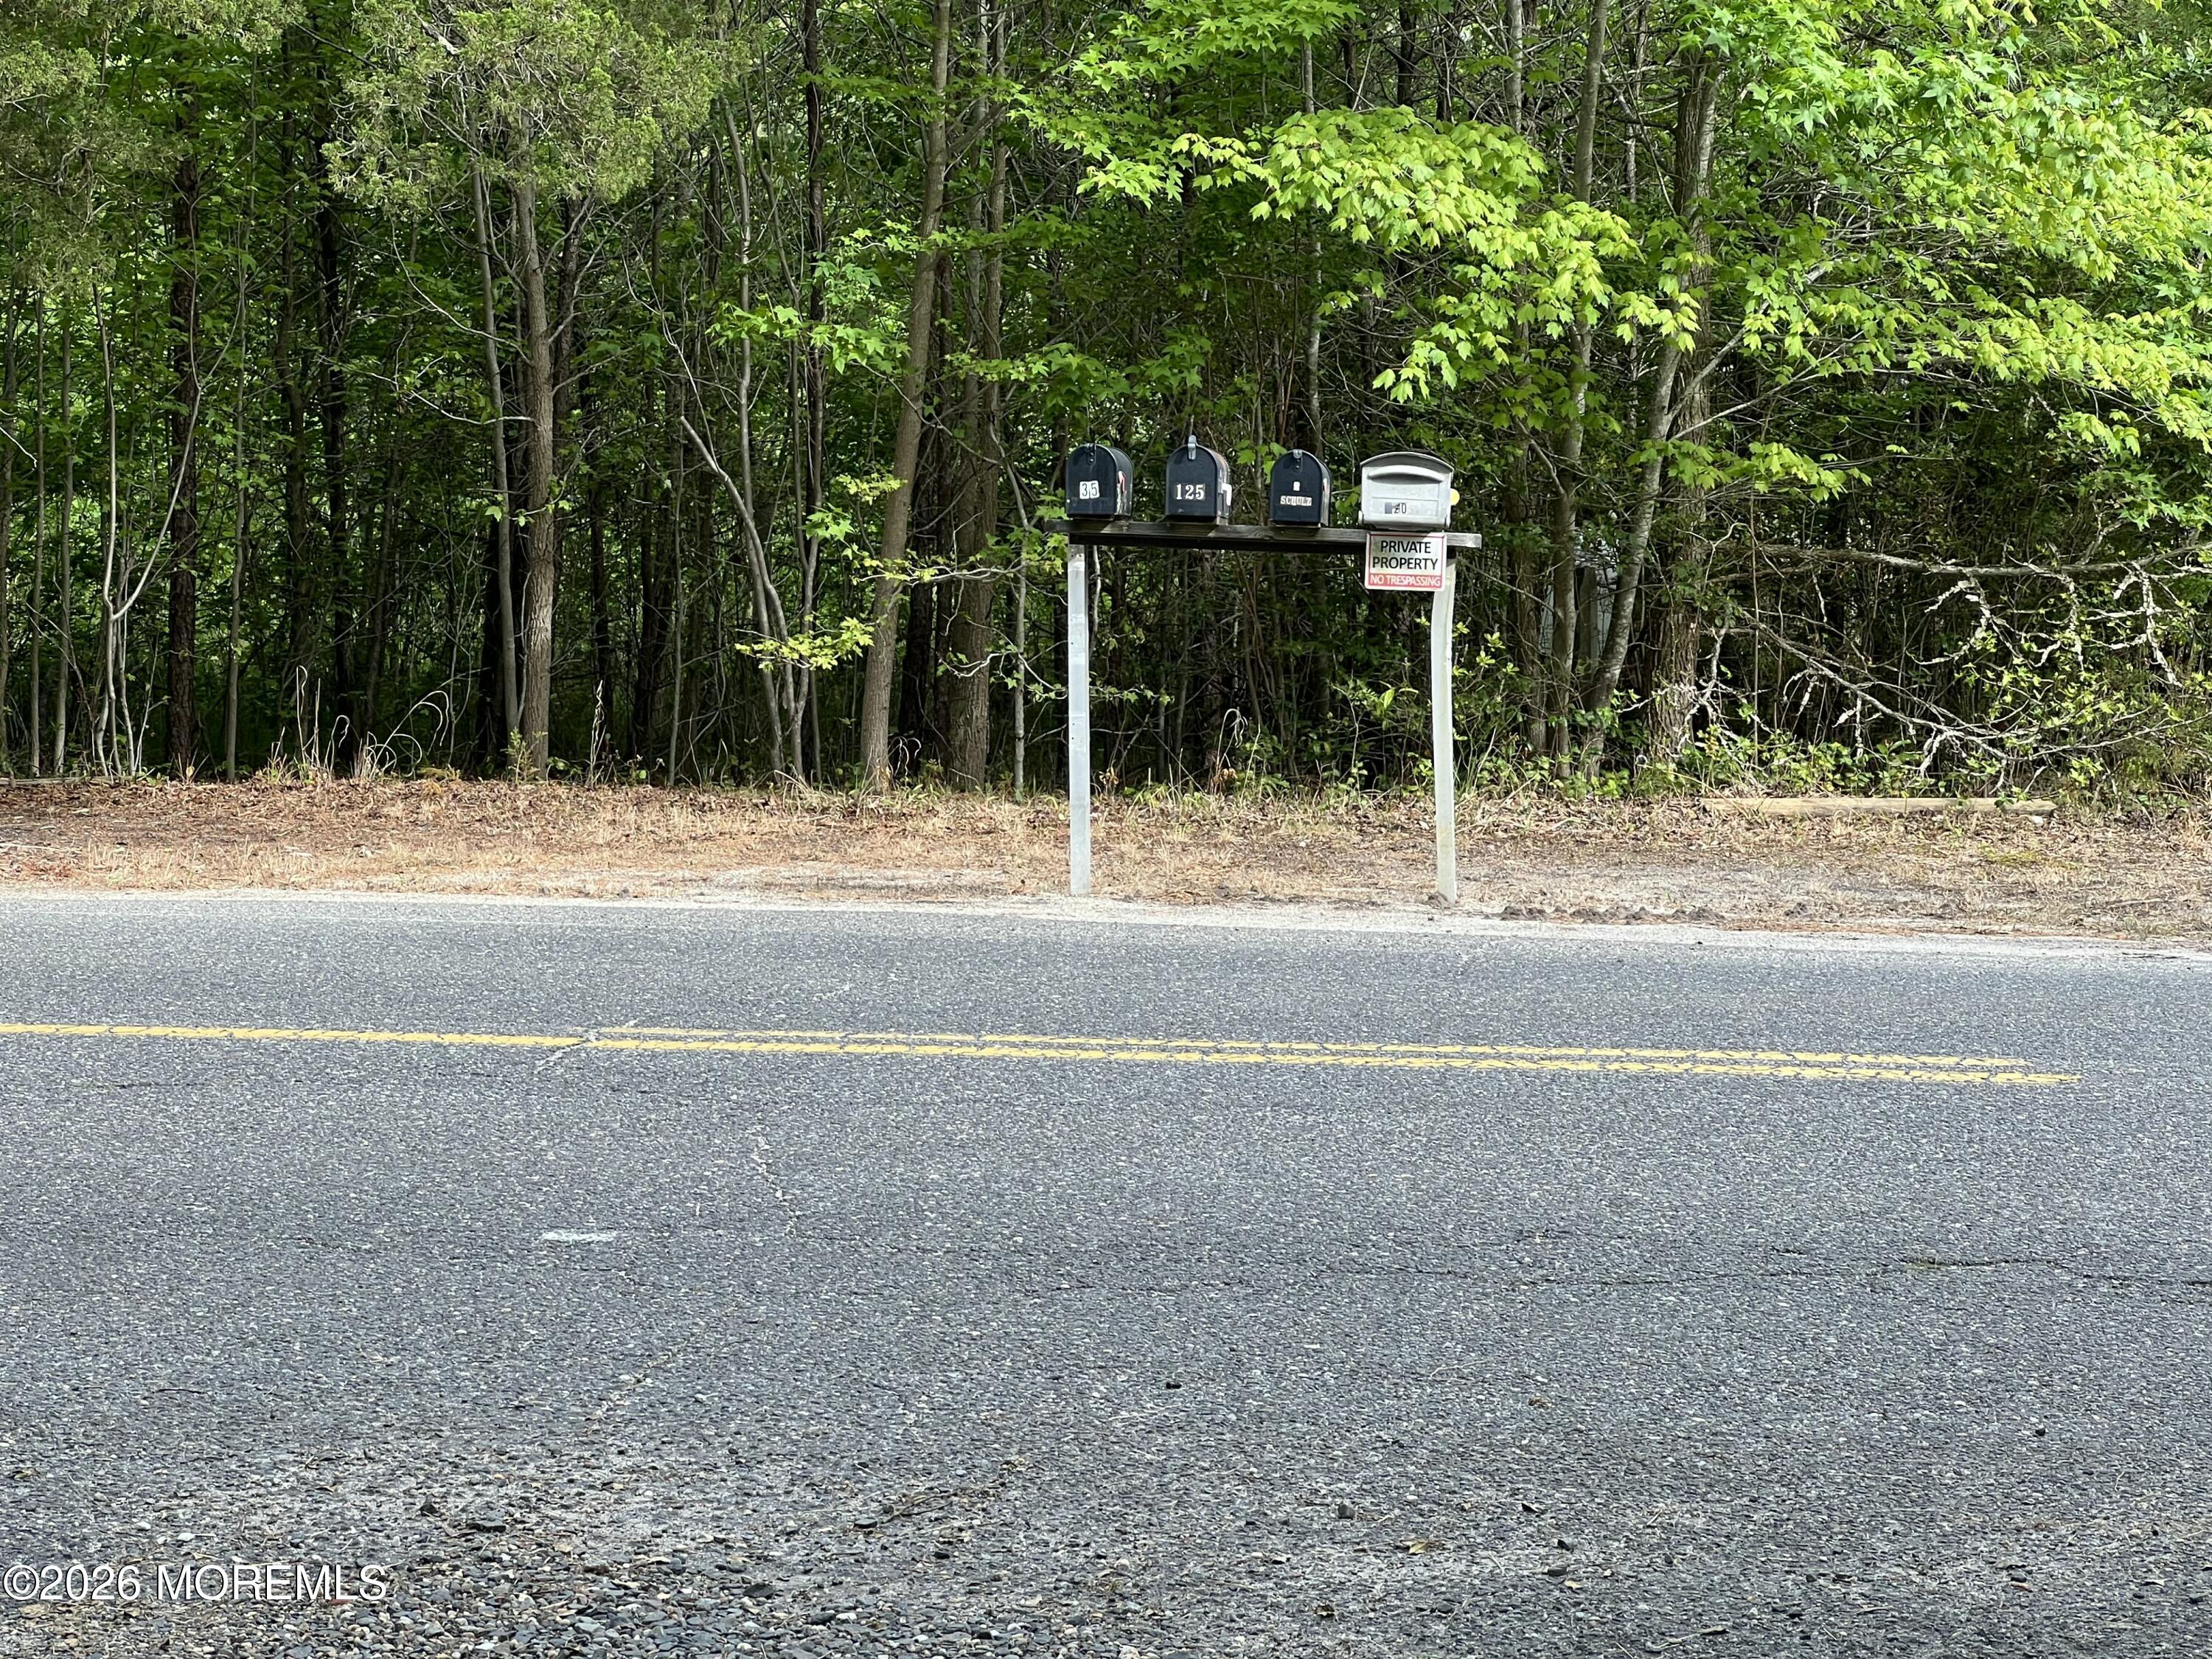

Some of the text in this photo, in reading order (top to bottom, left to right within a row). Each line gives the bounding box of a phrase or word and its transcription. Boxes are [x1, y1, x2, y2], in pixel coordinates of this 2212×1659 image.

[1081, 482, 1098, 497] 35
[1176, 484, 1205, 500] 125
[1380, 540, 1431, 554] PRIVATE
[1372, 557, 1438, 571] PROPERTY
[1370, 574, 1441, 587] NO TRESPASSING
